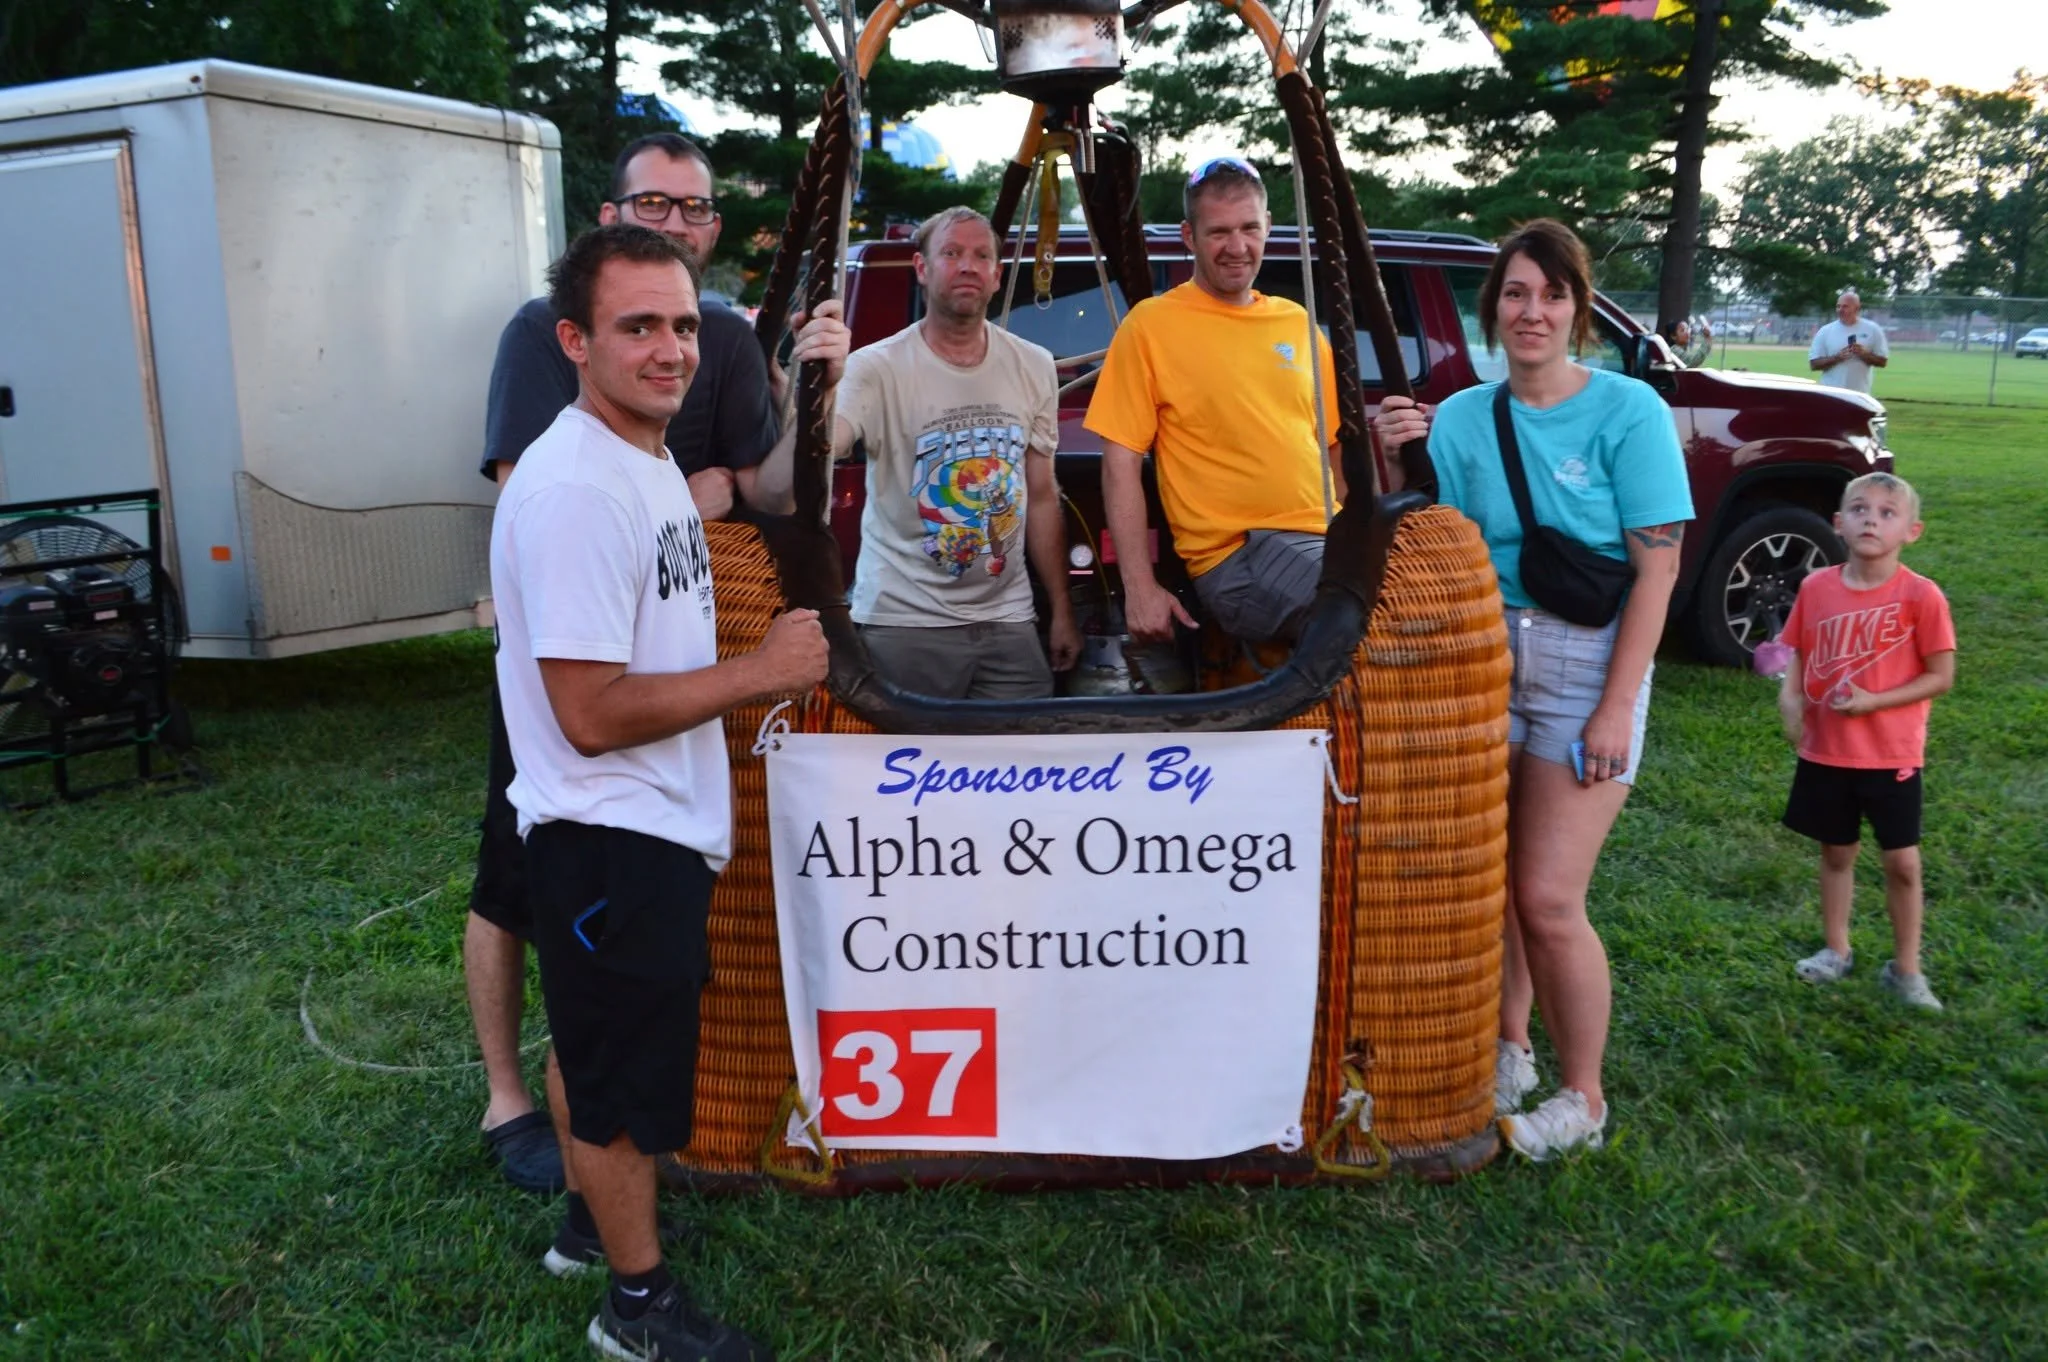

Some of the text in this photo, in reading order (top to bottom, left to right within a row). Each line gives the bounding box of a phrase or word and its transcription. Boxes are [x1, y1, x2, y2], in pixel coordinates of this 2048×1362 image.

[946, 418, 1004, 431] BALLOON
[1815, 602, 1902, 668] NIKE
[877, 745, 1215, 806] Sponsored By
[796, 816, 1297, 897] Alpha & Omega
[841, 913, 1251, 973] Construction
[830, 1029, 983, 1121] 37
